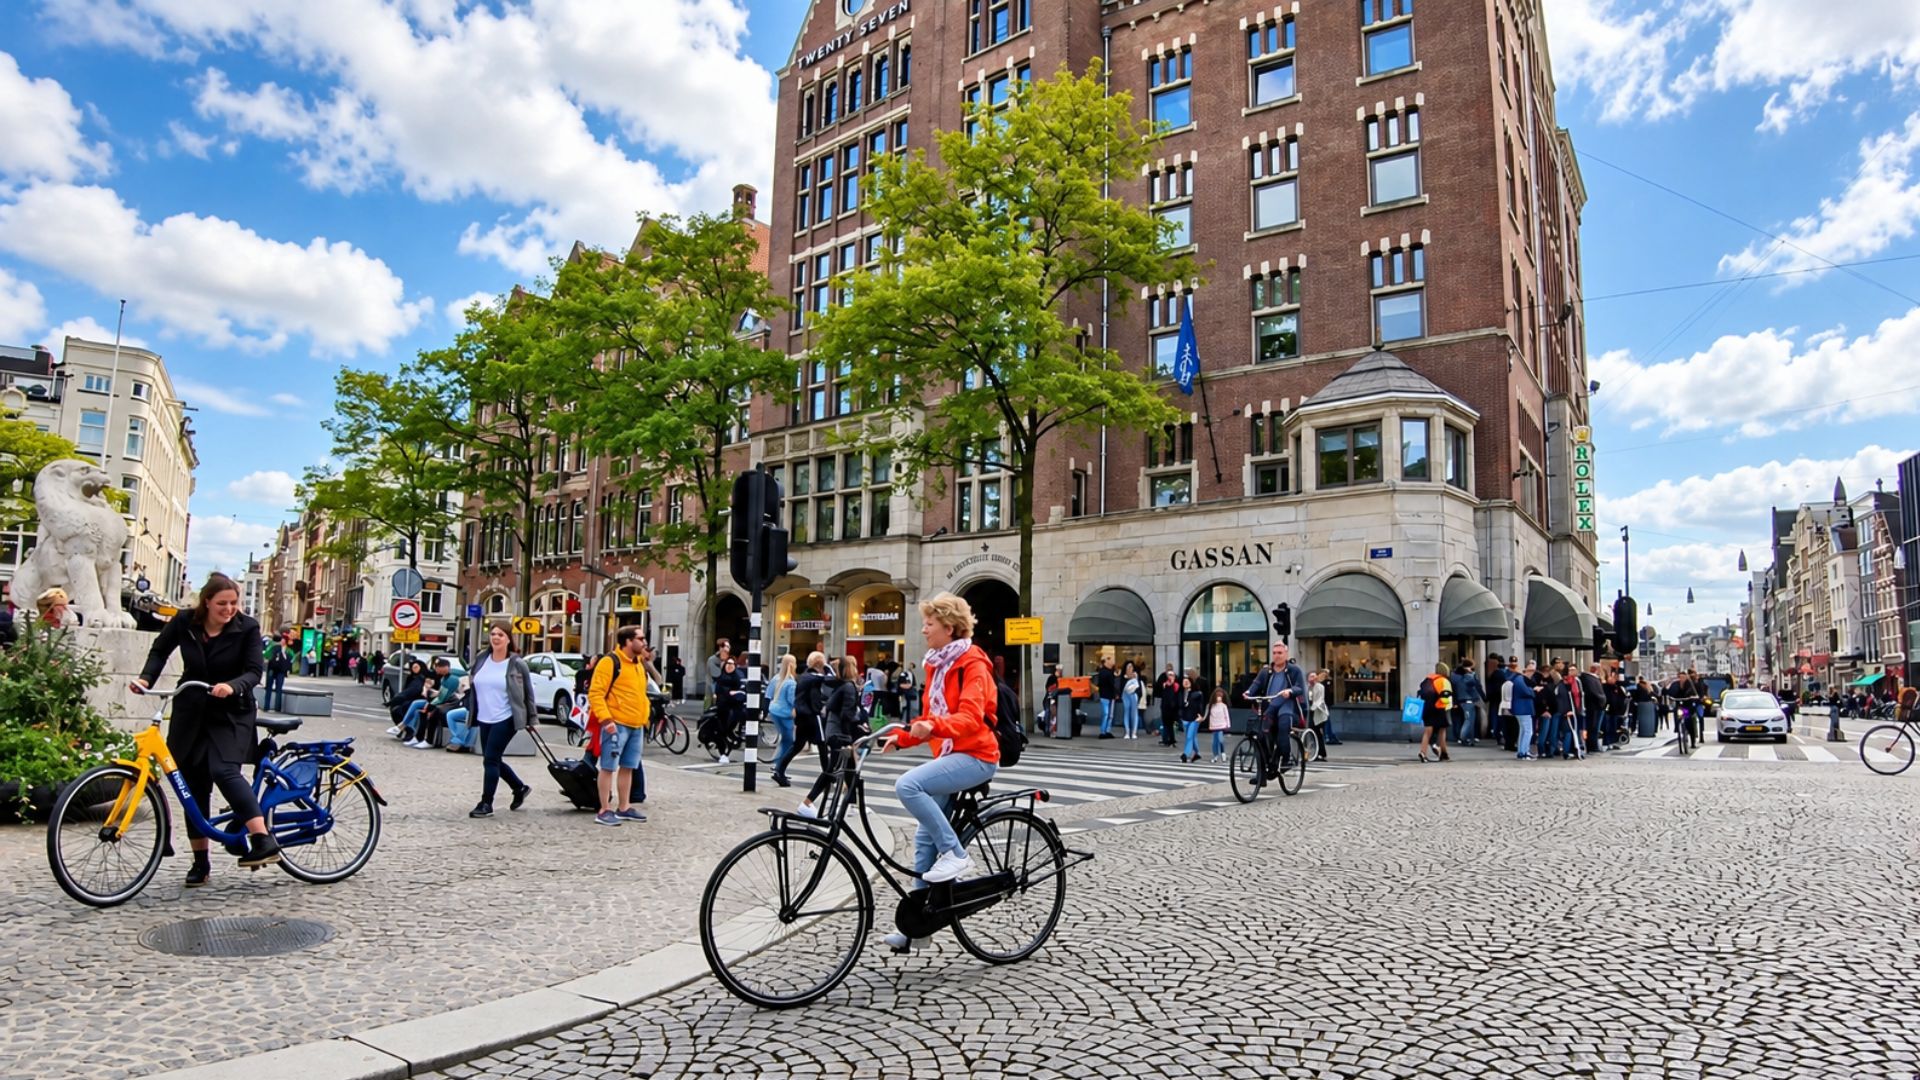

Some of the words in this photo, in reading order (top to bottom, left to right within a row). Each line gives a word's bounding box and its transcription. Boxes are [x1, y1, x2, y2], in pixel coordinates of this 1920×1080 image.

[797, 30, 853, 70] TWENTY
[859, 0, 909, 36] SEVEN
[1576, 446, 1592, 529] ROLEX
[1170, 541, 1274, 570] GASSAN
